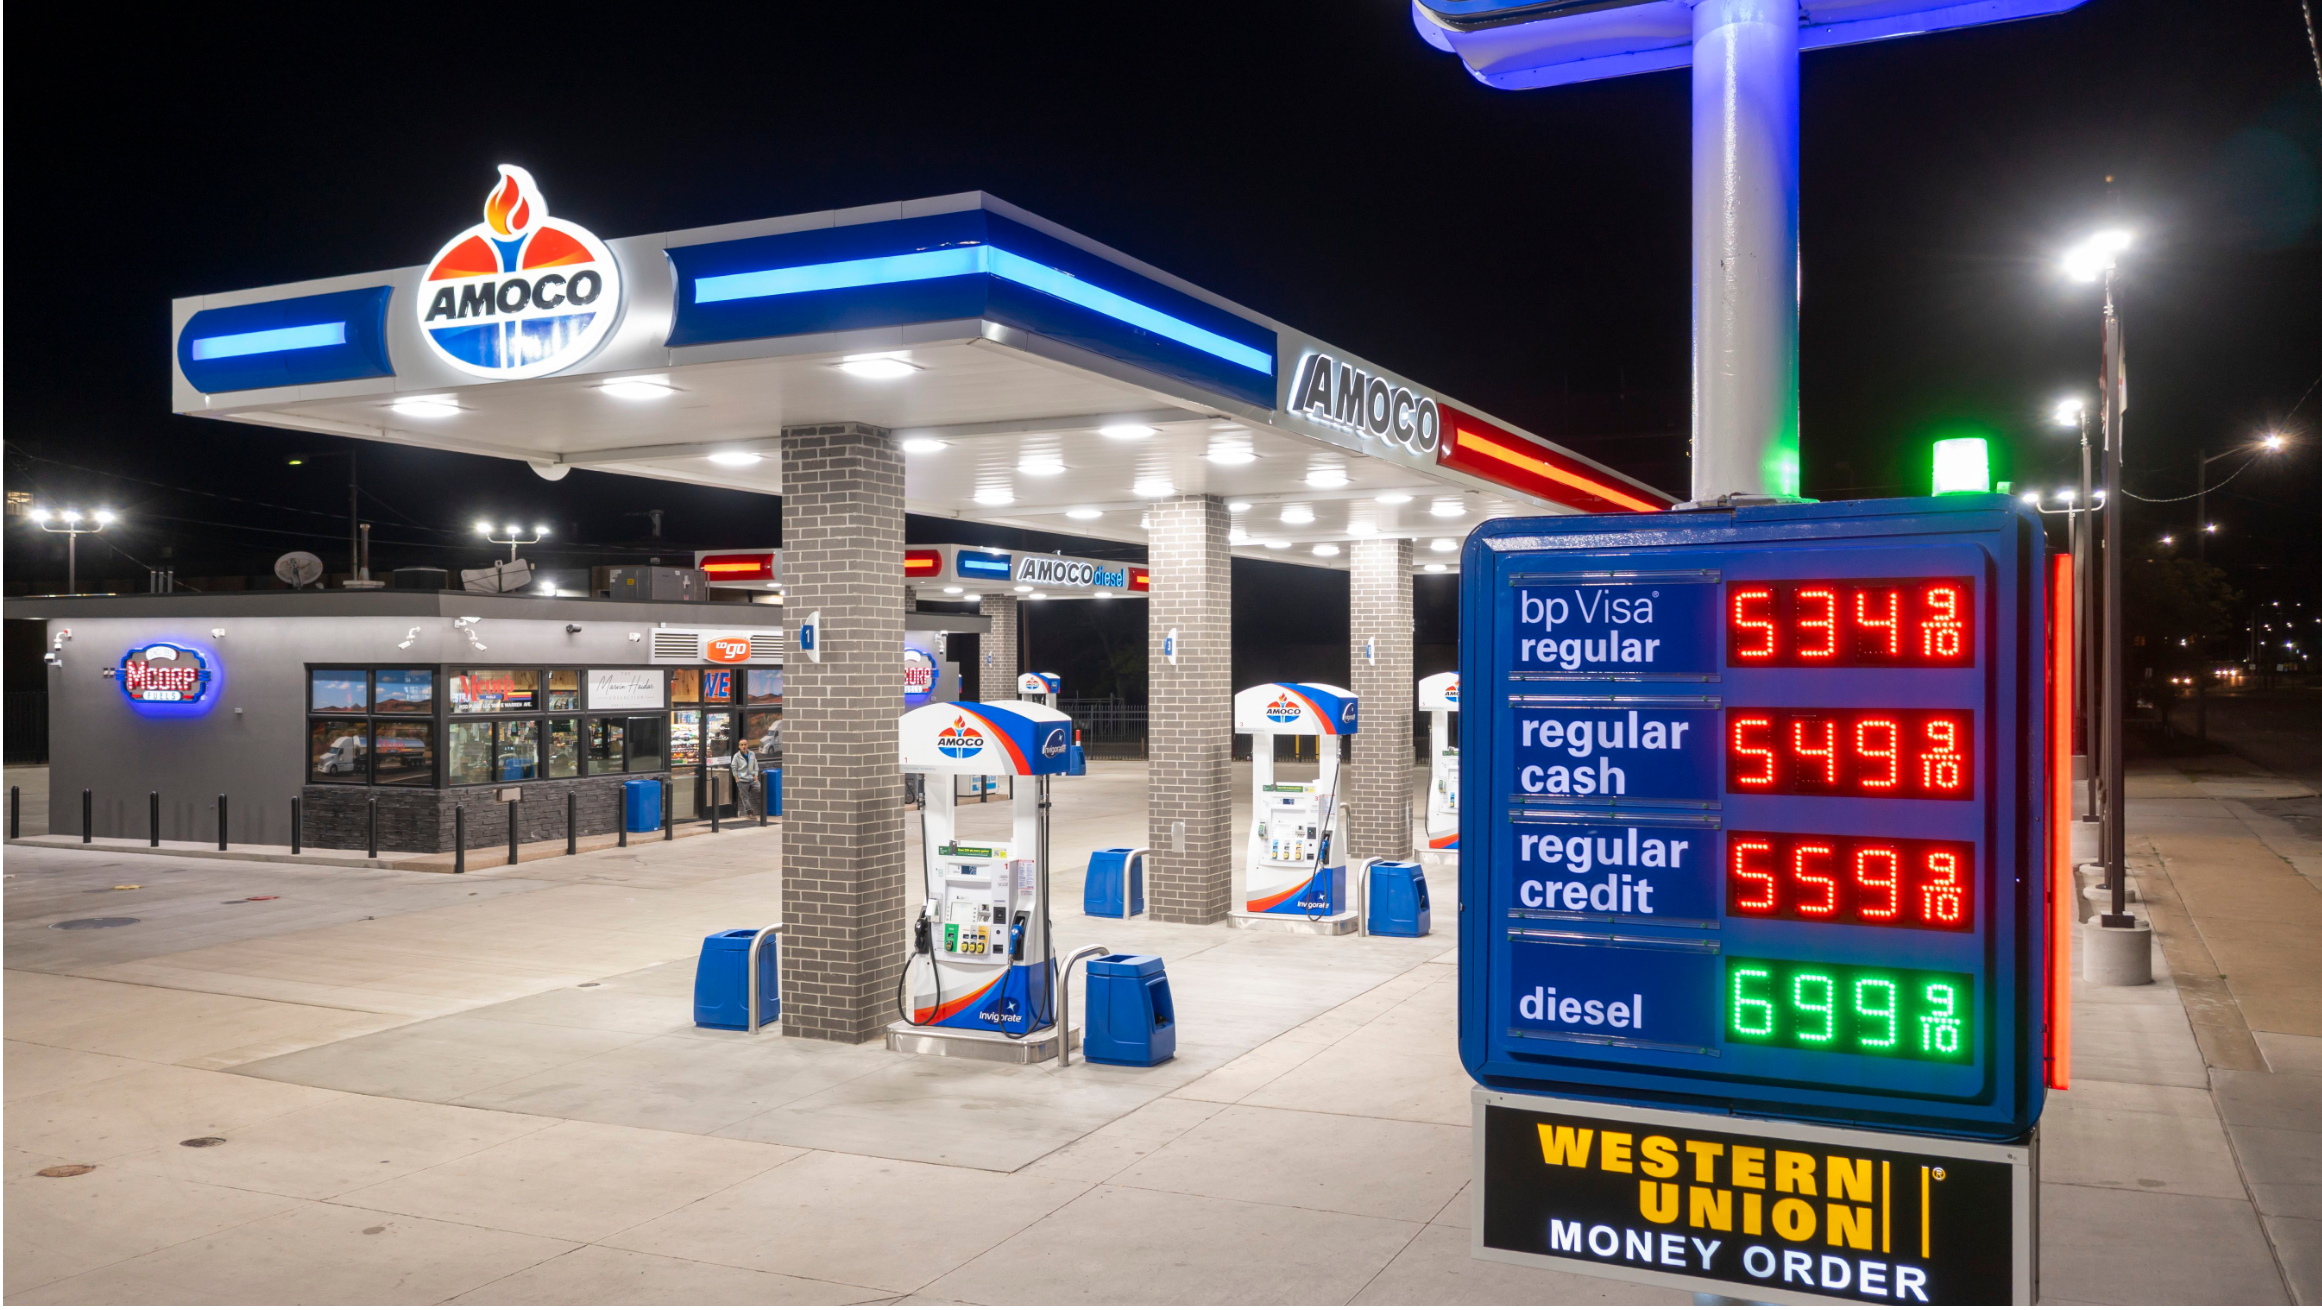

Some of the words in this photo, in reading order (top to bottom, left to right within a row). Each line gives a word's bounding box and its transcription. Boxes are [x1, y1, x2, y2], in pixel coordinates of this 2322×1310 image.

[424, 269, 602, 322] AMOCO
[1294, 353, 1439, 453] AMOCO
[1018, 558, 1094, 586] AMOCO
[1093, 566, 1125, 587] diesel
[1521, 589, 1569, 632] bp
[716, 641, 727, 649] to
[725, 643, 747, 659] go
[805, 629, 811, 643] 1
[1521, 630, 1660, 670] regular
[146, 692, 176, 700] FUELS
[937, 738, 984, 747] AMOCO
[1522, 710, 1689, 757] regular
[1521, 756, 1626, 795] cash
[1521, 827, 1689, 873] regular
[1520, 873, 1654, 914] credit
[1519, 986, 1642, 1029] diesel
[1536, 1123, 1873, 1203] WESTERN
[1639, 1180, 1873, 1251] UNION
[1550, 1219, 1722, 1270] MONEY
[1742, 1245, 1929, 1302] ORDER
